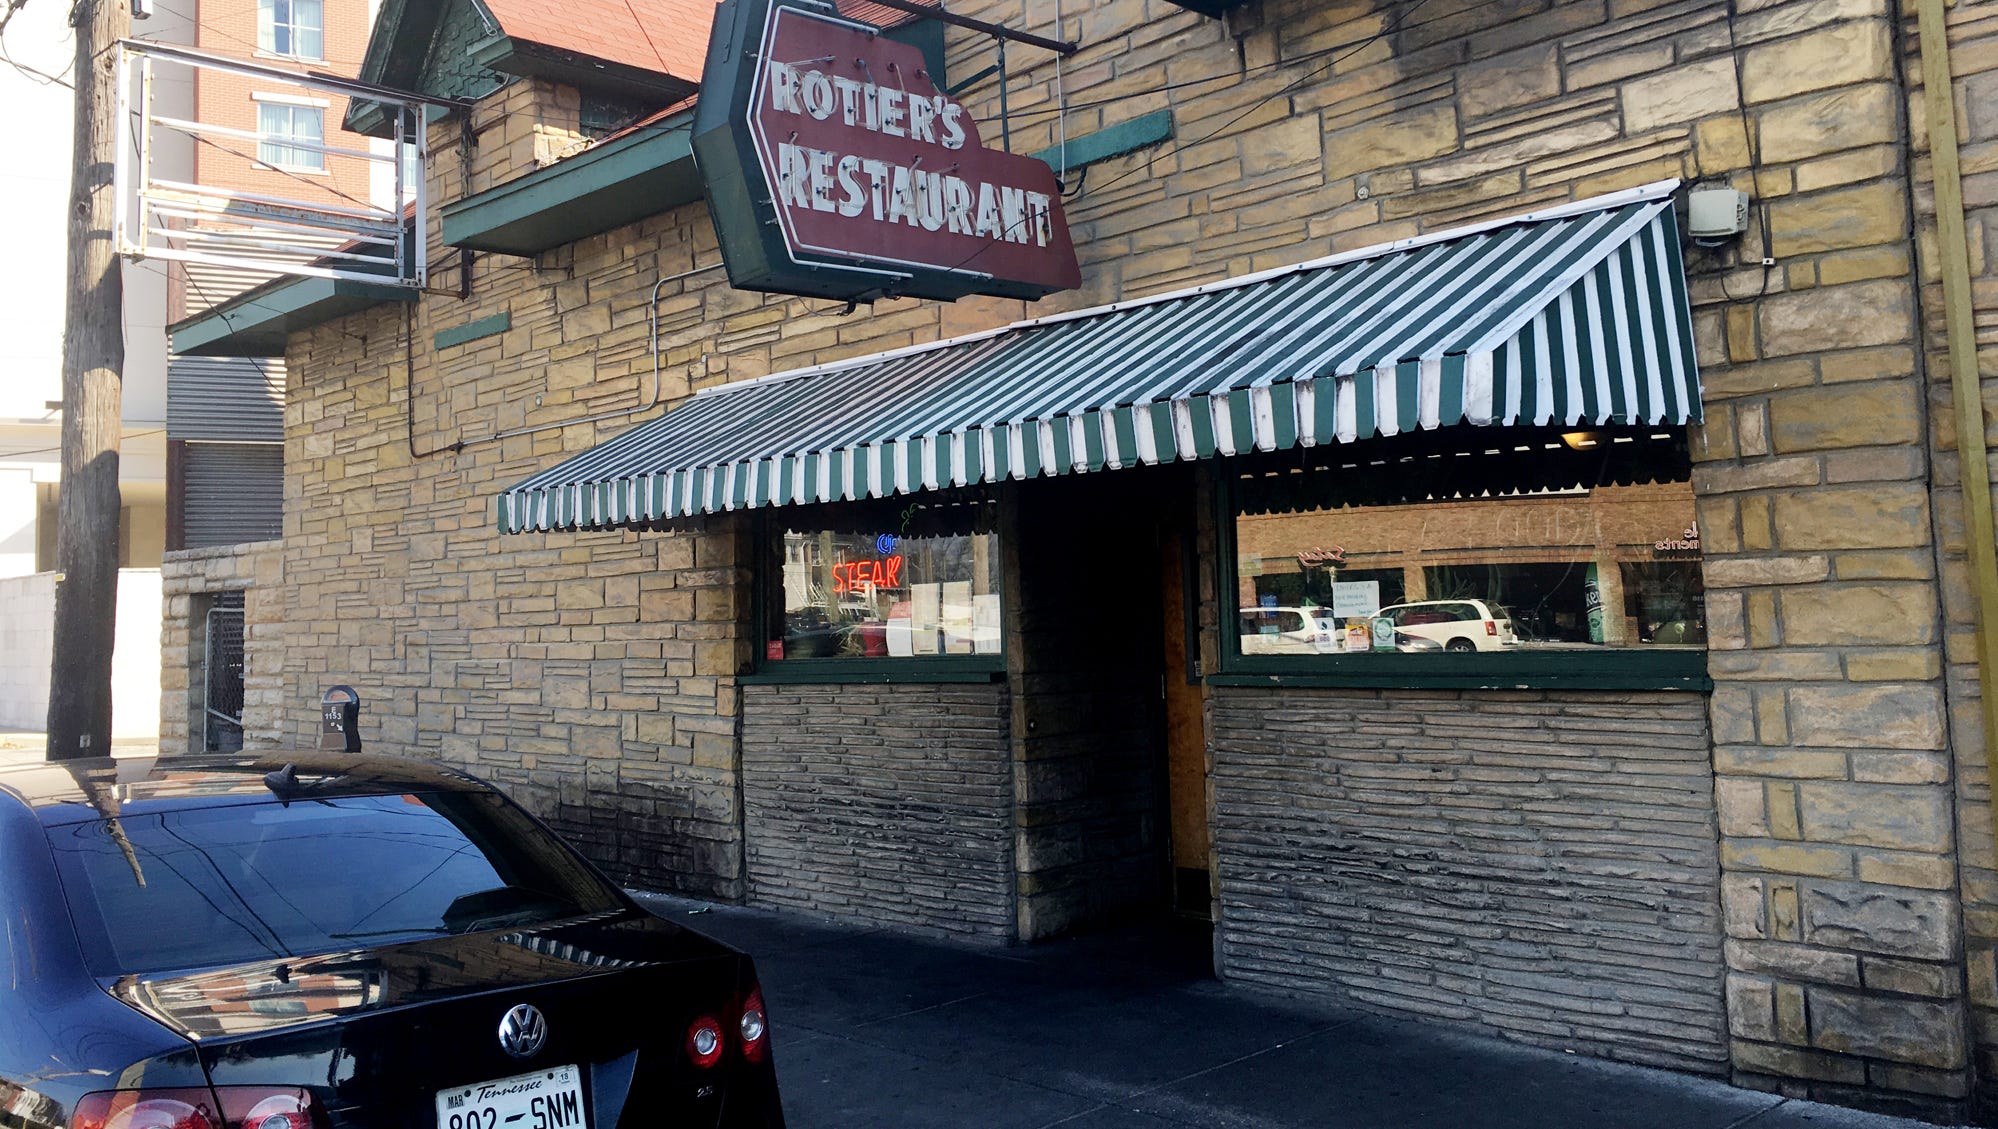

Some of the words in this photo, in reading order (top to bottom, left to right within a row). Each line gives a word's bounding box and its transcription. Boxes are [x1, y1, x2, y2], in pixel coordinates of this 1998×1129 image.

[770, 61, 966, 150] ROTIER'S
[778, 142, 1054, 248] RESTAURANT
[832, 555, 902, 593] STEAK
[324, 712, 342, 720] 1153
[331, 706, 337, 714] E
[447, 1095, 464, 1109] MAR
[477, 1081, 542, 1103] Tennessee
